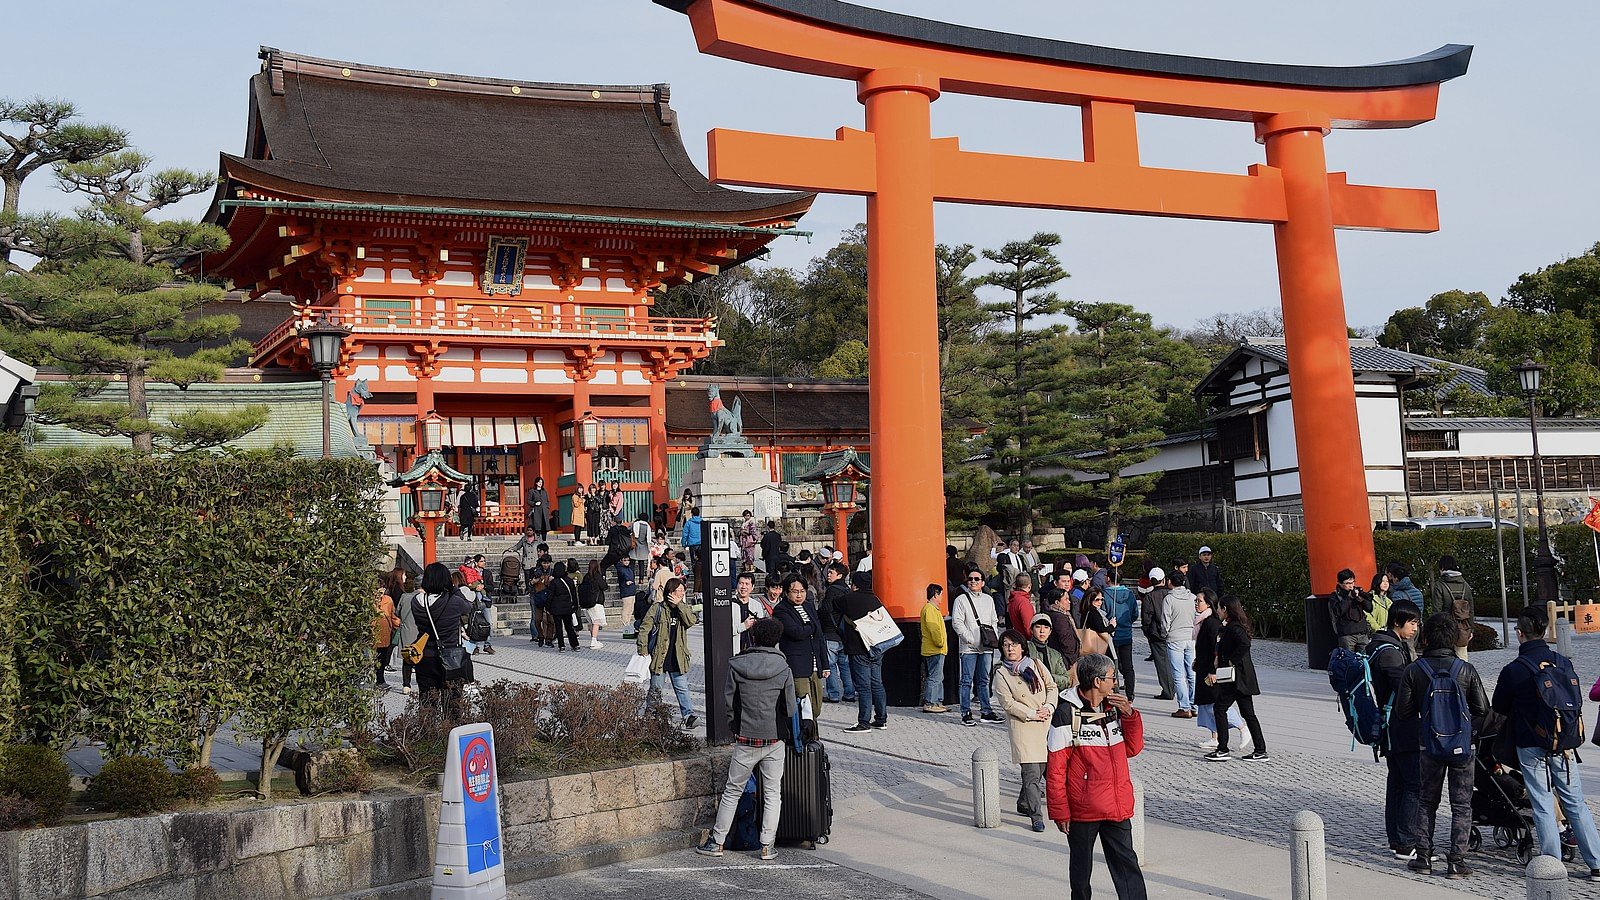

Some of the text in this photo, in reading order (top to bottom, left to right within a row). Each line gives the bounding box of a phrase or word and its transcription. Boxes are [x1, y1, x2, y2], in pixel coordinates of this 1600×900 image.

[714, 588, 727, 596] Rest
[713, 598, 730, 607] Room
[1584, 613, 1593, 625] 車
